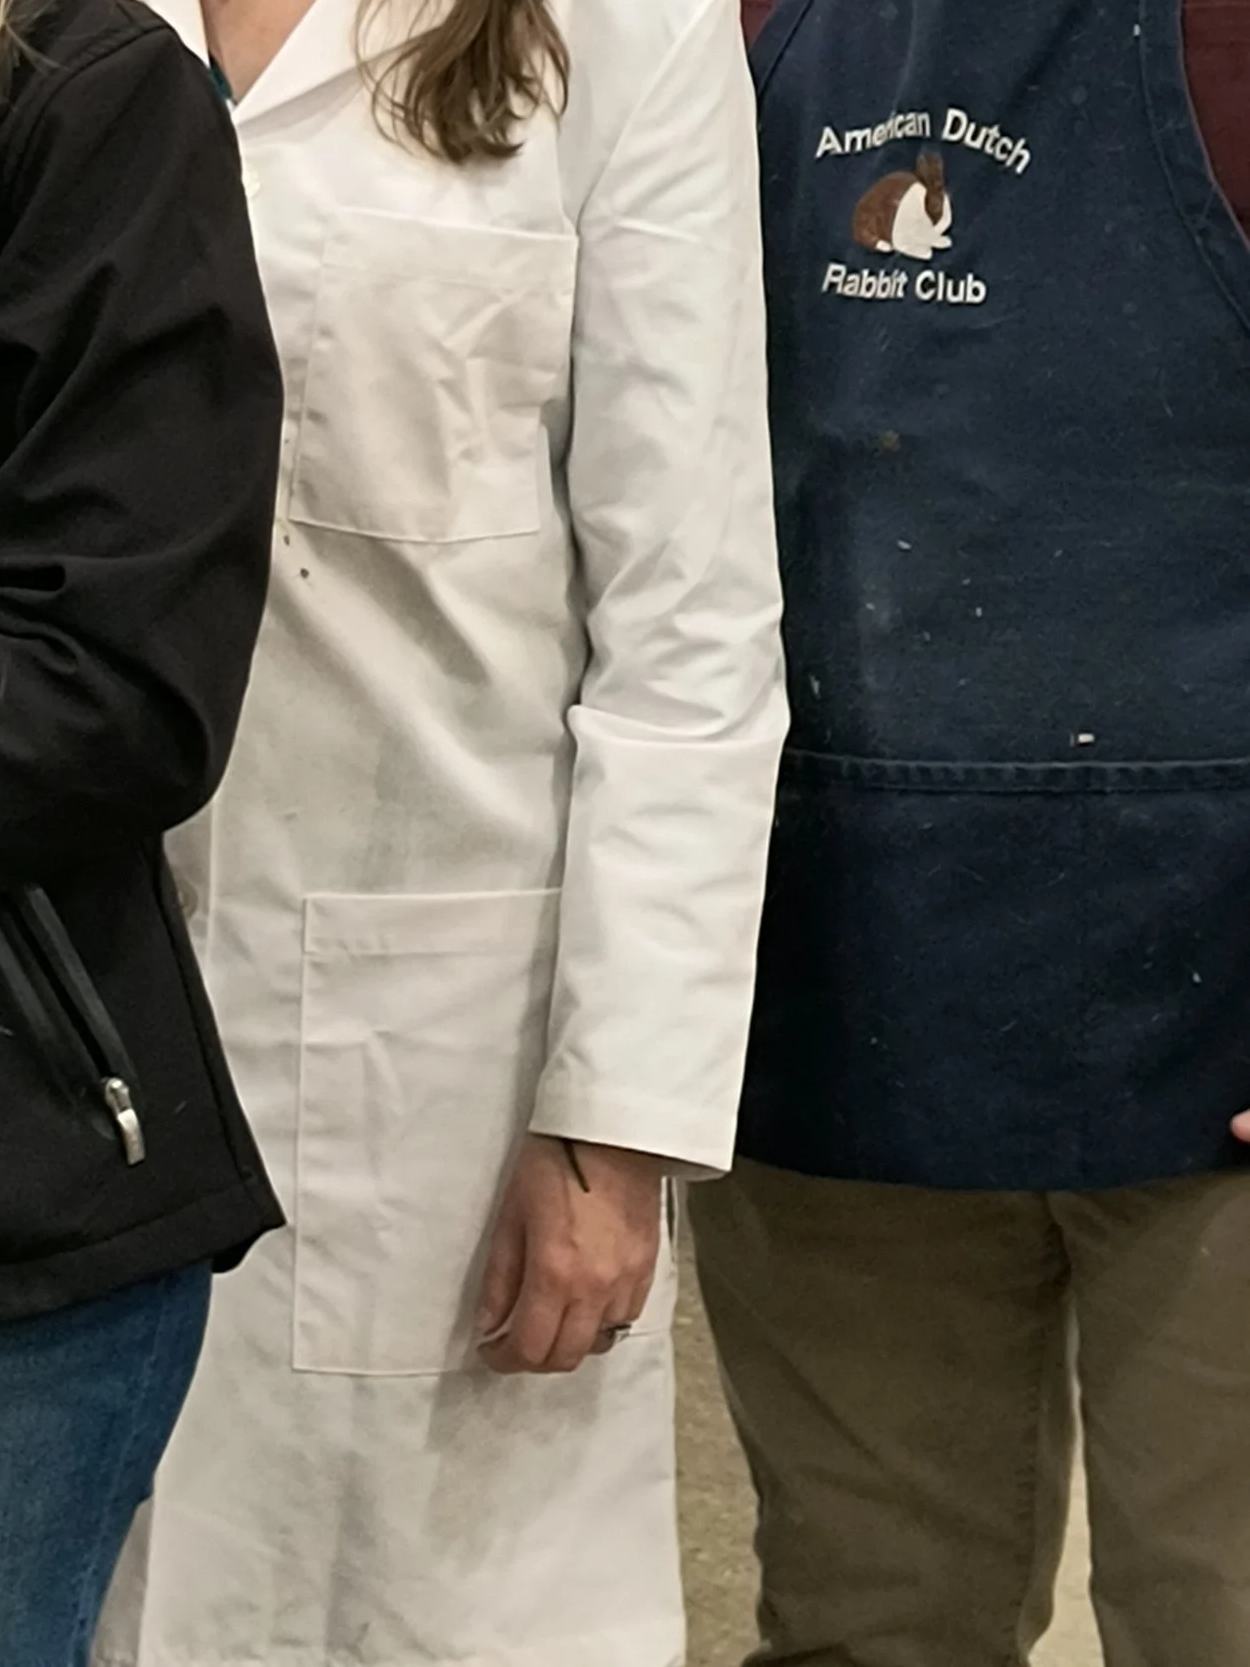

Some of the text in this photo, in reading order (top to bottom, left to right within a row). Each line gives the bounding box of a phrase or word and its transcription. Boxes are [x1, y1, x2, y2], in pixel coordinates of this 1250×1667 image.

[815, 107, 1032, 175] American Dutch
[821, 262, 987, 304] Rabbit Club
